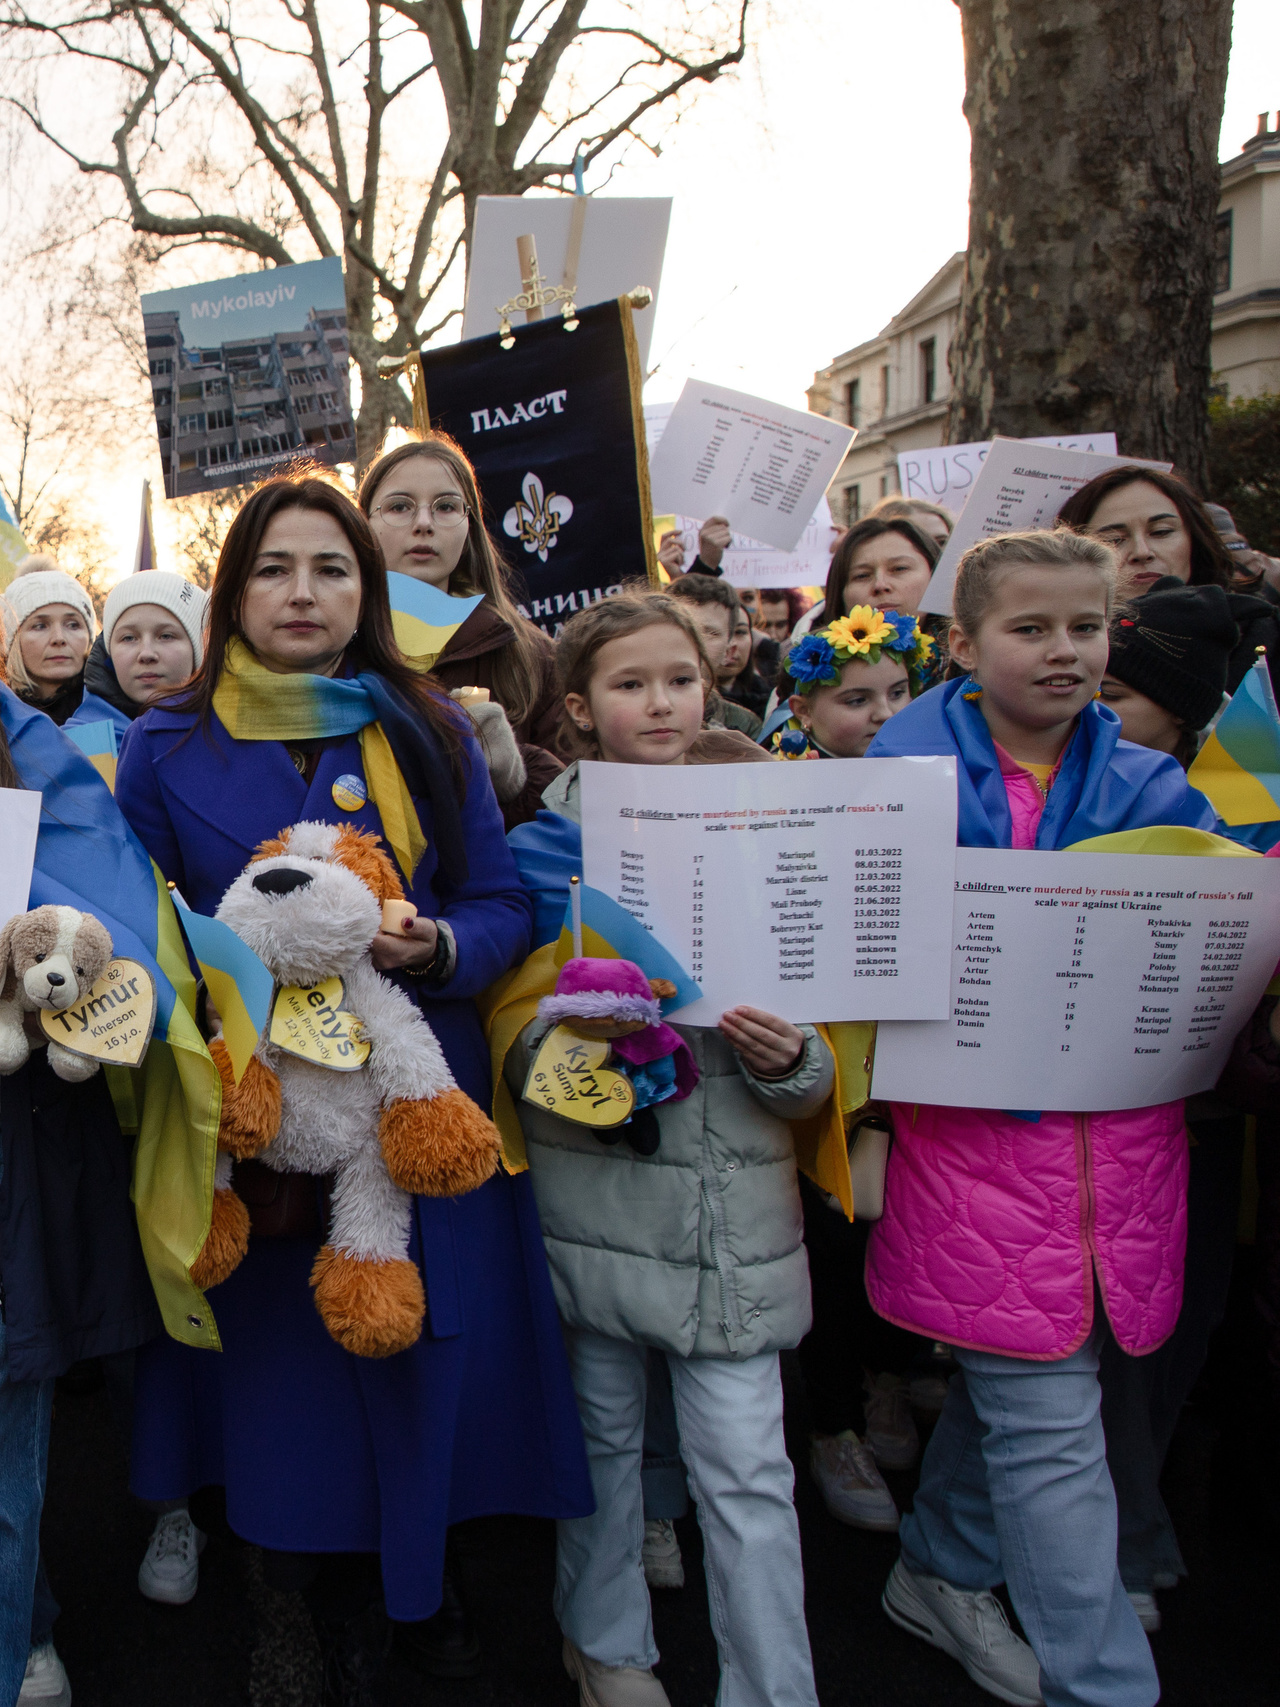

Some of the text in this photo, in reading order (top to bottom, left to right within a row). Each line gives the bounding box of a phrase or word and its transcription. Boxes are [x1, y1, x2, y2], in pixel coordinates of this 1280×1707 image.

[191, 284, 296, 319] Mykolayiv
[471, 389, 567, 433] ПЛАСТ
[636, 809, 675, 820] children
[677, 811, 700, 819] were
[702, 809, 748, 819] murdered
[749, 808, 759, 818] by
[762, 807, 787, 816] russia
[808, 805, 833, 814] result
[835, 804, 846, 813] of
[886, 803, 903, 812] full
[778, 850, 815, 860] Mariupol
[855, 848, 902, 856] 01.03.2022
[962, 882, 1005, 893] children
[1007, 885, 1032, 893] were
[1034, 886, 1082, 895] murdered
[1085, 887, 1098, 897] by
[1101, 888, 1130, 897] russia
[1133, 890, 1143, 898] as
[1155, 890, 1184, 899] result
[1186, 890, 1197, 899] of
[1237, 892, 1253, 900] full
[1035, 898, 1058, 907] scale
[1082, 900, 1118, 910] against
[1121, 901, 1162, 911] Ukraine
[967, 922, 994, 930] Artem
[1150, 930, 1185, 938] Kharkiv
[1147, 919, 1191, 928] Rybakivka
[1208, 920, 1249, 928] 06.03.2022
[955, 944, 1002, 954] Artemchyk
[1153, 952, 1176, 960] Izium
[107, 969, 121, 980] 82
[959, 977, 991, 985] Bohdan
[1138, 985, 1179, 994] Mohnatyn
[52, 977, 140, 1033] Tymur
[90, 1009, 136, 1038] Kherson
[284, 1018, 297, 1030] 12
[299, 982, 355, 1056] enys
[287, 996, 332, 1060] Mali Prohody
[104, 1028, 142, 1051] 16 y.o.
[534, 1072, 546, 1083] 6
[552, 1062, 579, 1101] Sumy
[564, 1044, 611, 1109] Kyryl
